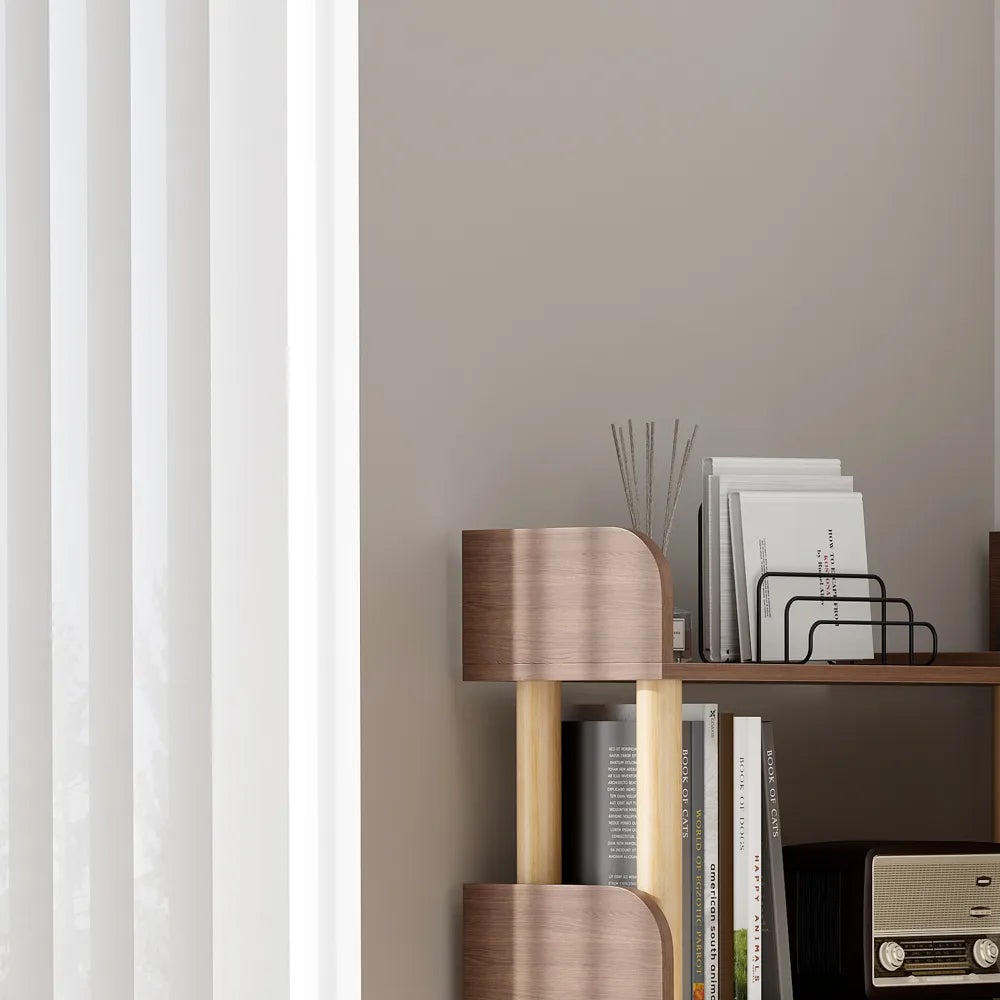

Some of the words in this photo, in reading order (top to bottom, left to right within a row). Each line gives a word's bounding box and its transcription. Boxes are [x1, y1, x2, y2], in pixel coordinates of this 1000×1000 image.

[766, 750, 775, 783] BOOK
[682, 788, 689, 804] OF
[769, 788, 777, 804] OF
[771, 808, 779, 838] CATS
[695, 856, 702, 871] OF
